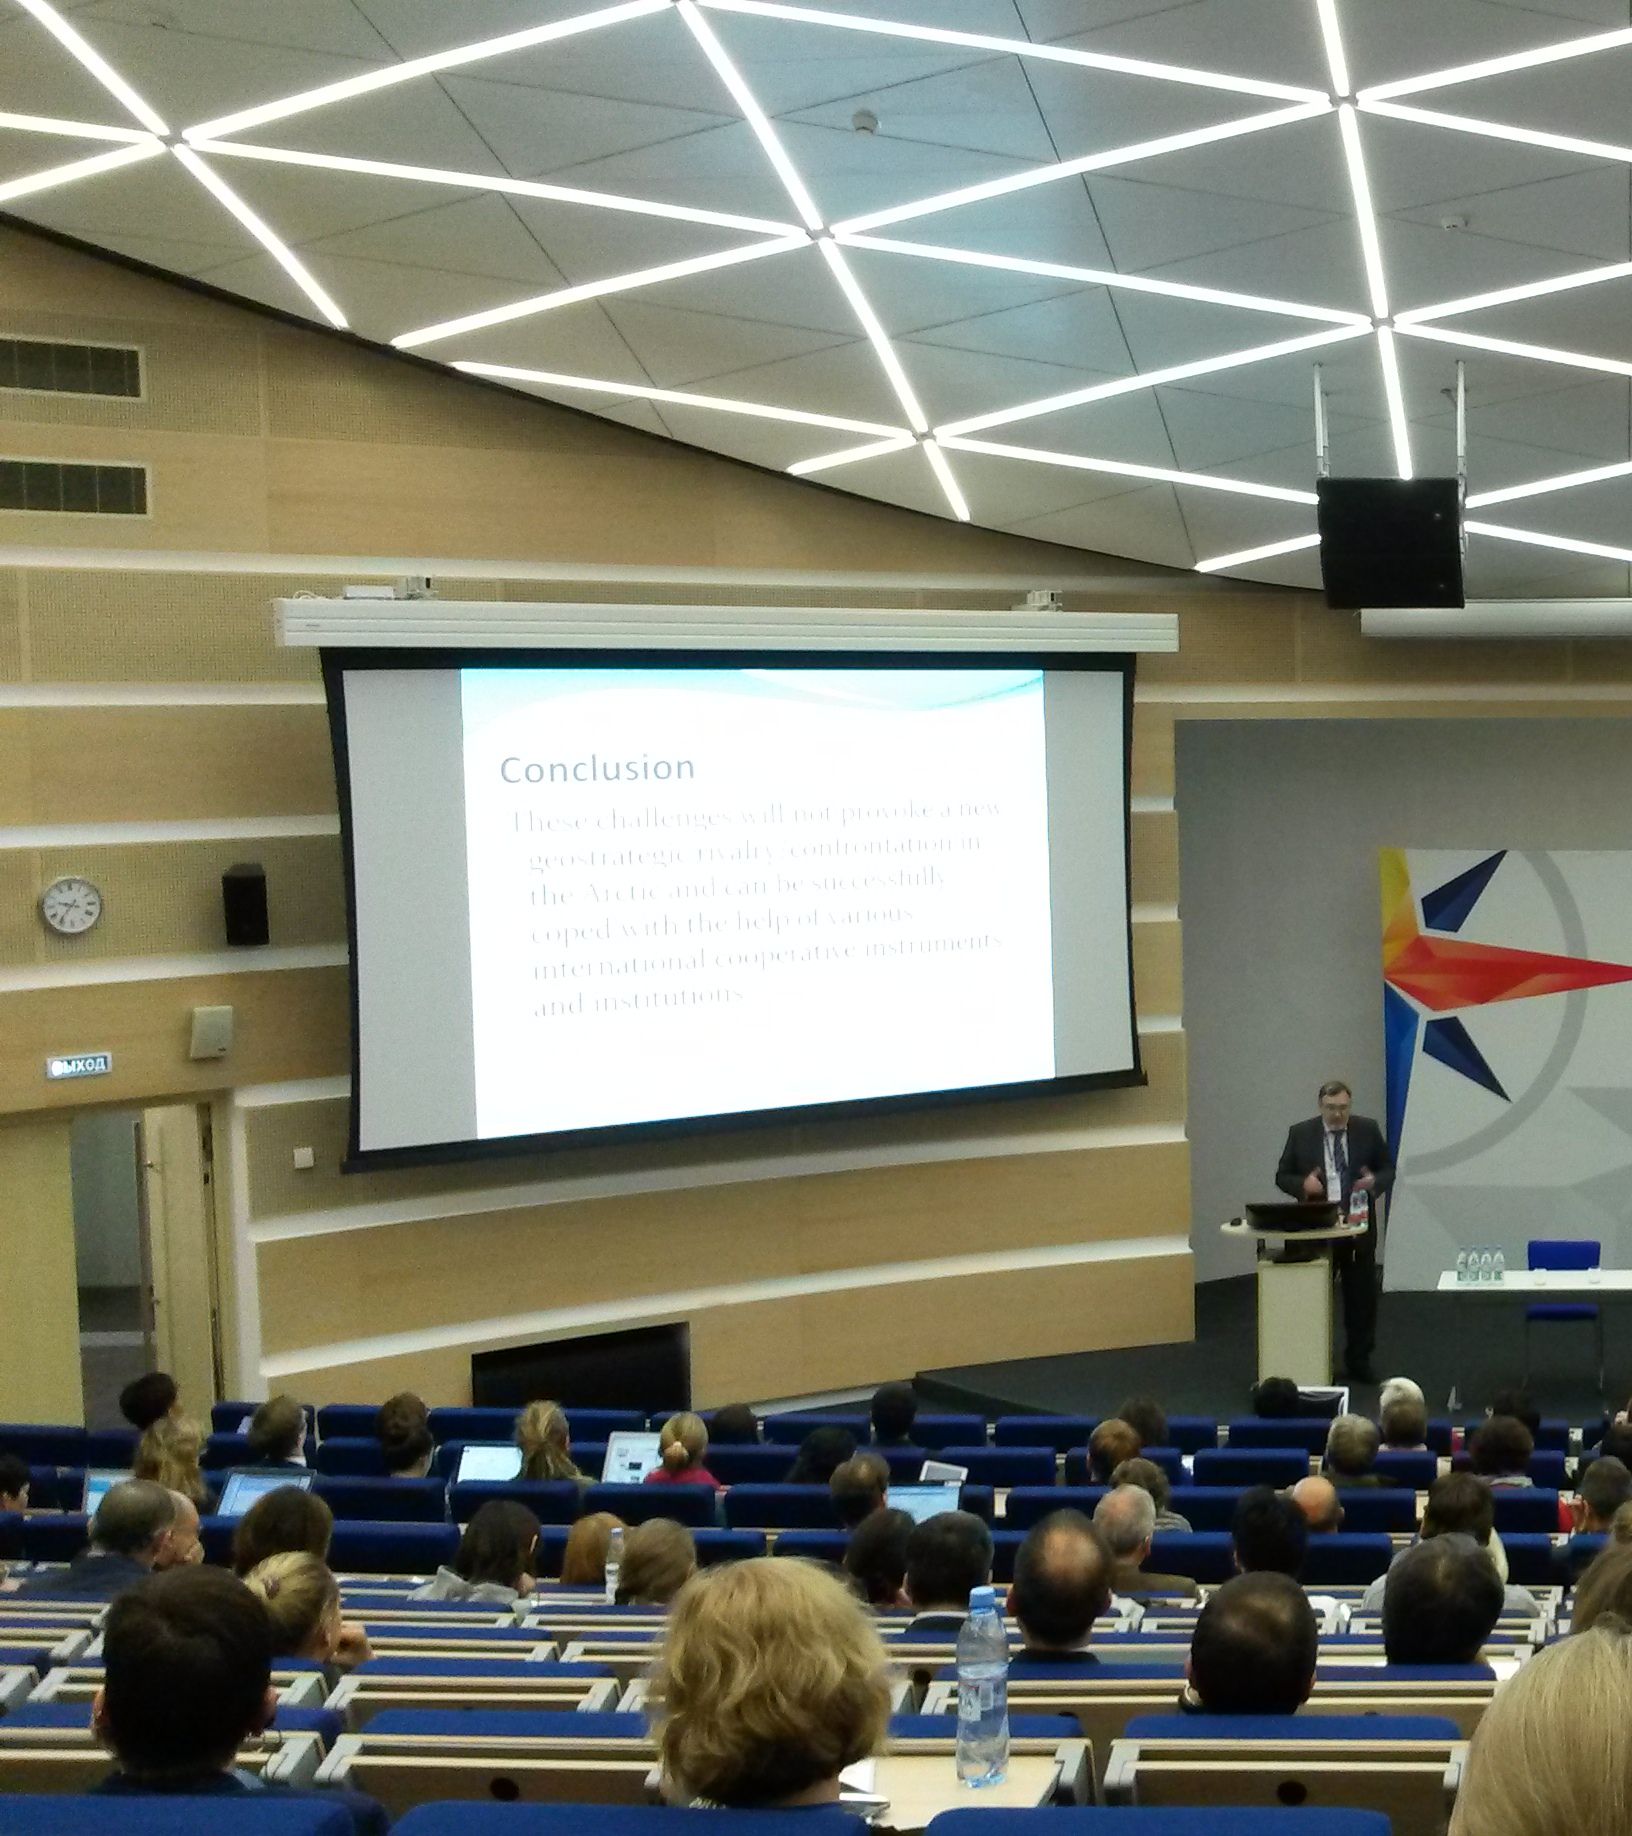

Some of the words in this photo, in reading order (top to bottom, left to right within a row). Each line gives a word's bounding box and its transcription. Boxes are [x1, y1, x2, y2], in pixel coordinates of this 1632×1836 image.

[501, 753, 695, 784] Conclusion
[506, 807, 588, 833] These
[597, 806, 732, 832] challenges
[741, 802, 784, 824] will
[793, 806, 832, 824] not
[841, 798, 934, 829] provoke
[959, 801, 1001, 818] new
[529, 848, 685, 875] geostrategic
[531, 883, 574, 905] the
[584, 882, 658, 904] Arctic
[669, 876, 716, 899] and
[724, 880, 767, 896] can
[776, 873, 803, 894] be
[532, 917, 610, 948] coped
[620, 914, 678, 937] with
[687, 912, 728, 934] the
[736, 908, 790, 935] help
[797, 907, 819, 926] of
[827, 908, 914, 925] various
[533, 948, 705, 980] international
[714, 944, 856, 972] cooperative
[865, 935, 1003, 957] instruments
[534, 991, 583, 1017] and
